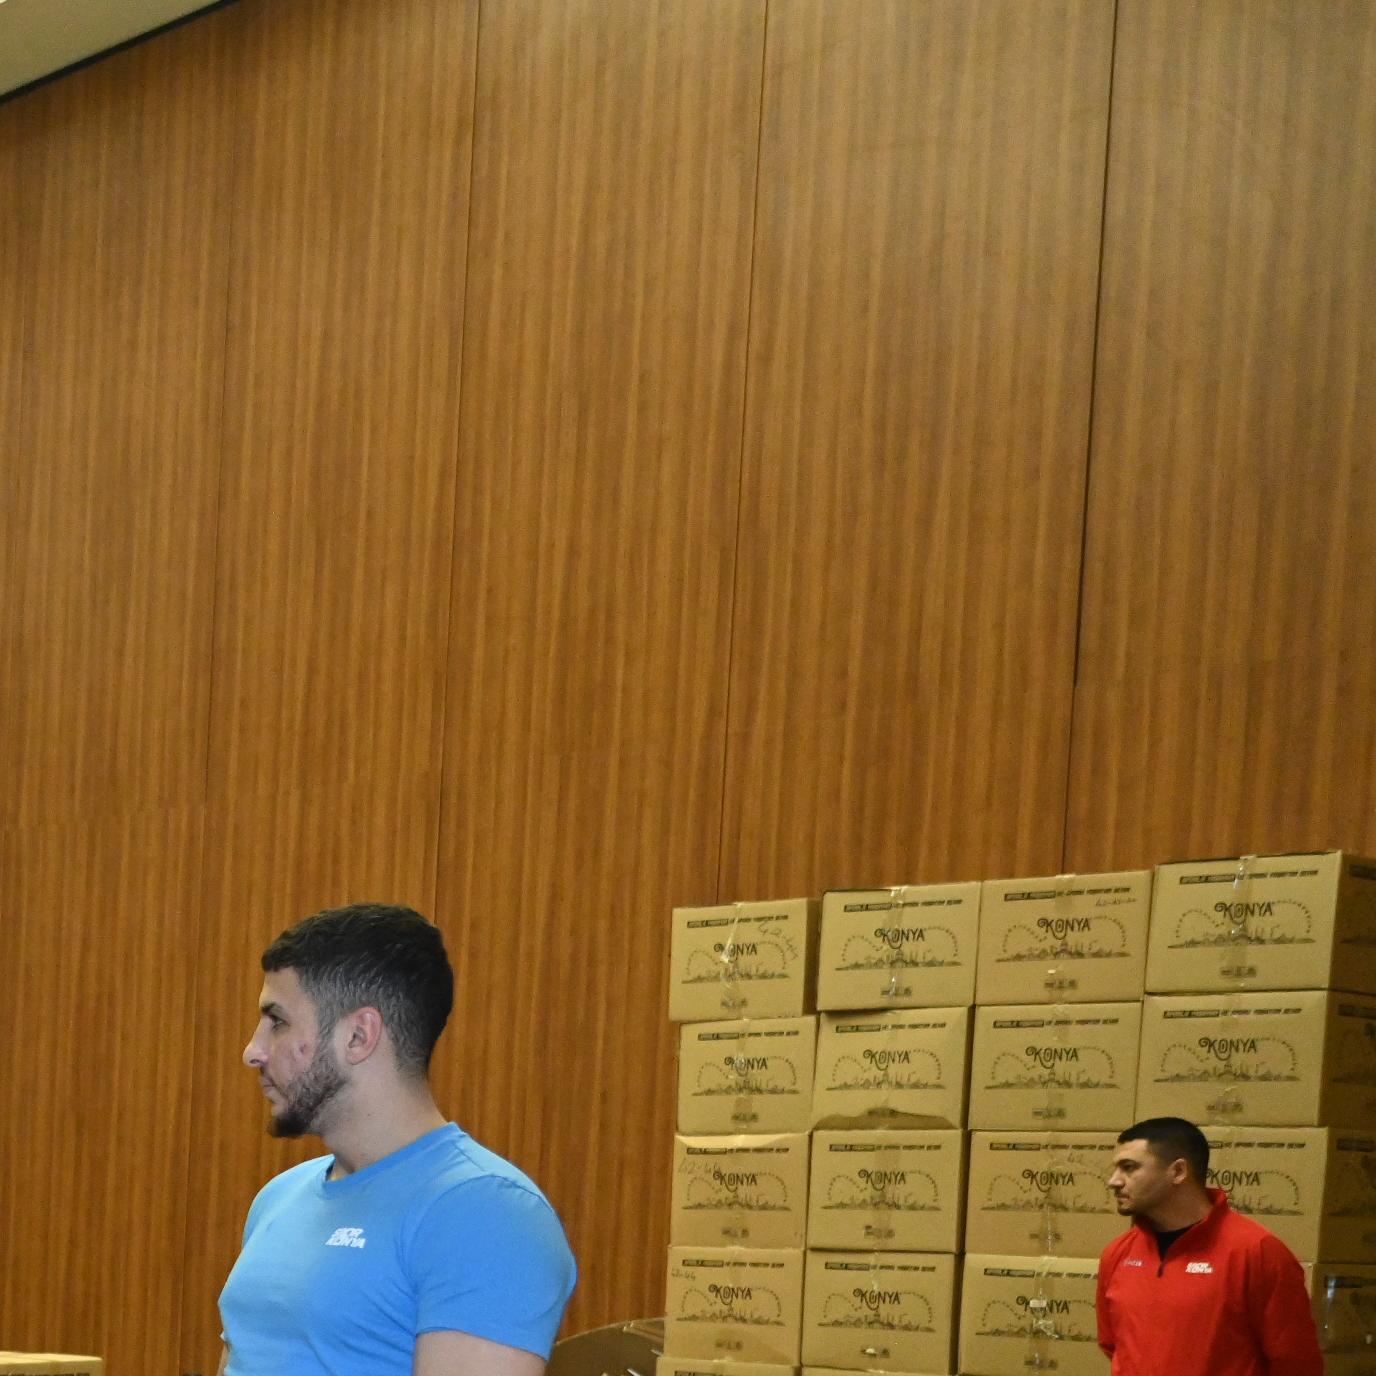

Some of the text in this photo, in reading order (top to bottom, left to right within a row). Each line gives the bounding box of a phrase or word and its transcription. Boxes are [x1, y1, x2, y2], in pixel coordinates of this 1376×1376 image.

[1214, 902, 1273, 925] KONYA
[874, 927, 925, 950] KONYA
[1038, 917, 1090, 940] KONYA
[863, 1049, 910, 1072] KONYA
[1025, 1046, 1079, 1069] KONYA
[1198, 1037, 1257, 1061] KONYA
[713, 1170, 758, 1192] KONYA
[858, 1169, 907, 1191] KONYA
[1022, 1169, 1074, 1193] KONYA
[708, 1283, 752, 1306] KONYA
[853, 1288, 901, 1311] KONYA
[1016, 1296, 1070, 1318] KNYA
